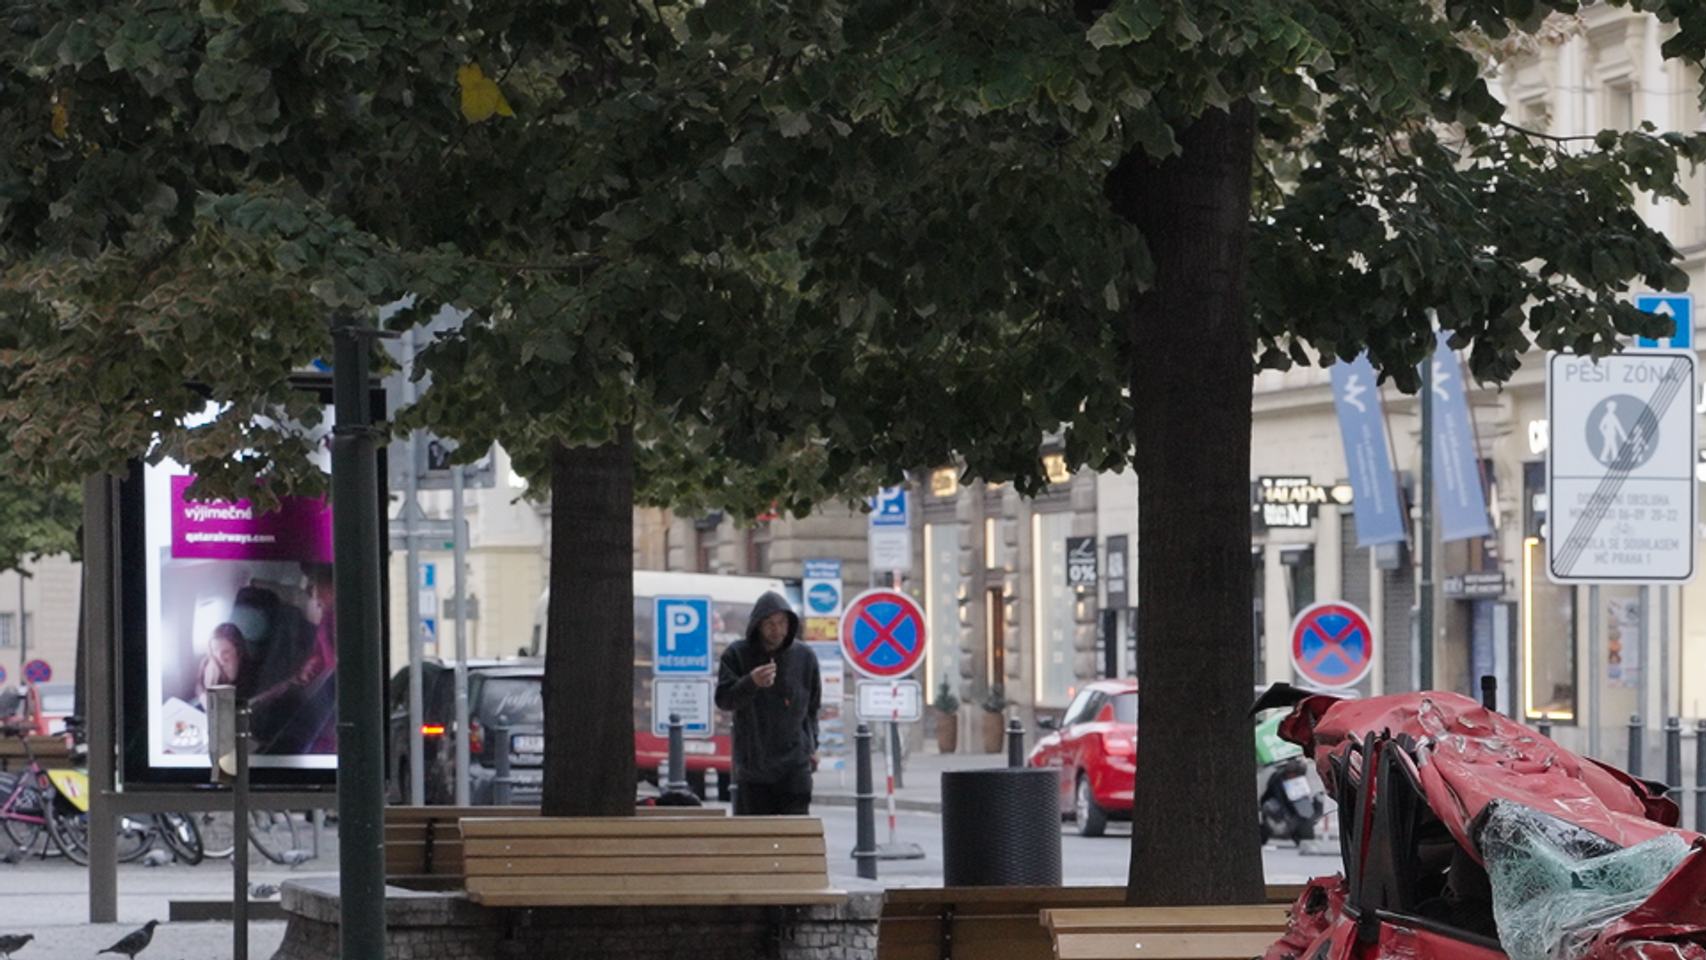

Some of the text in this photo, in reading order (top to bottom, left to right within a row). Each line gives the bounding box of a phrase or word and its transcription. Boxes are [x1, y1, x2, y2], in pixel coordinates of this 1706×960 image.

[1623, 361, 1680, 384] ZÓNA
[184, 505, 253, 522] výjimečné
[184, 530, 276, 545] qatarairways.com
[1623, 538, 1680, 551] SOUHLASEM
[1612, 554, 1644, 566] PRAHA
[1069, 565, 1097, 581] 0%
[665, 604, 700, 651] P
